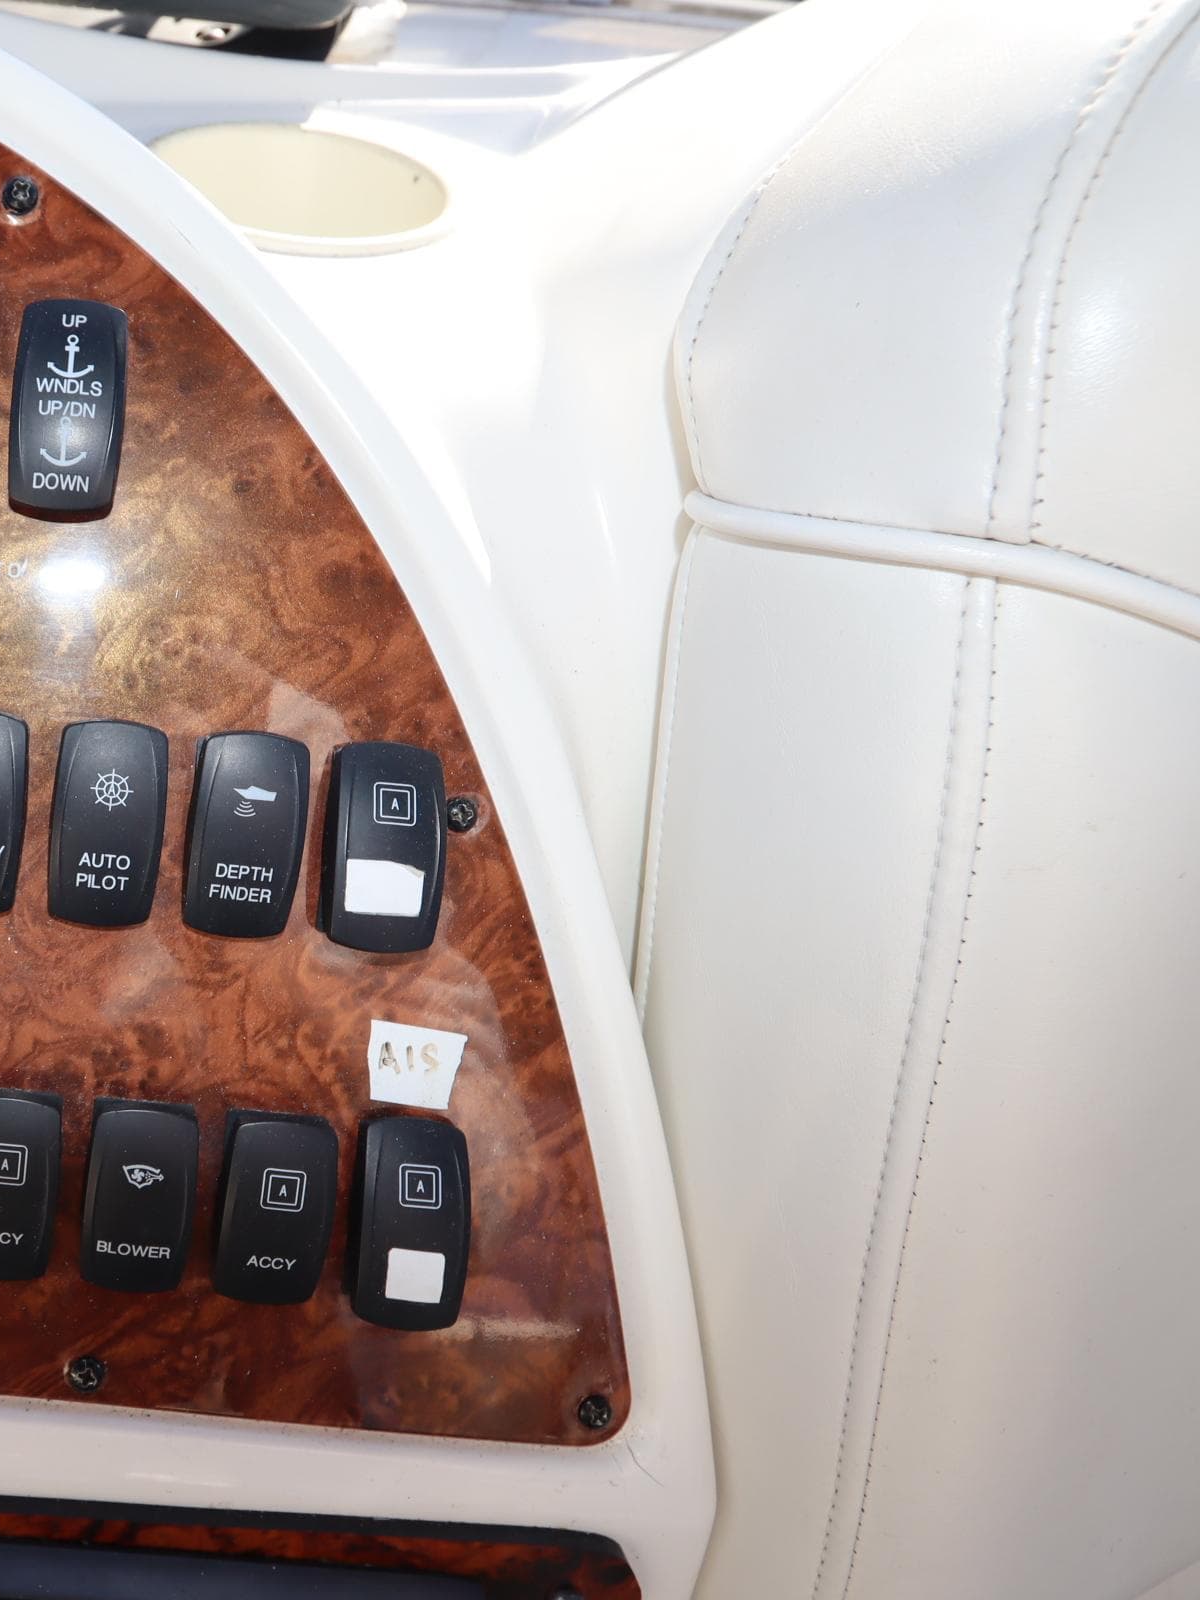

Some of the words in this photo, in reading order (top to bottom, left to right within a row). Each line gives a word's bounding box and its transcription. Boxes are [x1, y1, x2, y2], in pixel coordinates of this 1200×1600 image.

[61, 313, 88, 328] UP
[36, 375, 103, 397] WNDLS
[38, 399, 96, 421] UP/DN
[32, 472, 90, 493] DOWN
[78, 852, 131, 871] AUTO
[75, 872, 130, 891] PILOT
[215, 862, 274, 883] DEPTH
[208, 883, 272, 904] FINDER
[378, 1041, 441, 1075] AIS
[96, 1239, 171, 1259] BLOWER
[246, 1255, 297, 1271] ACCY
